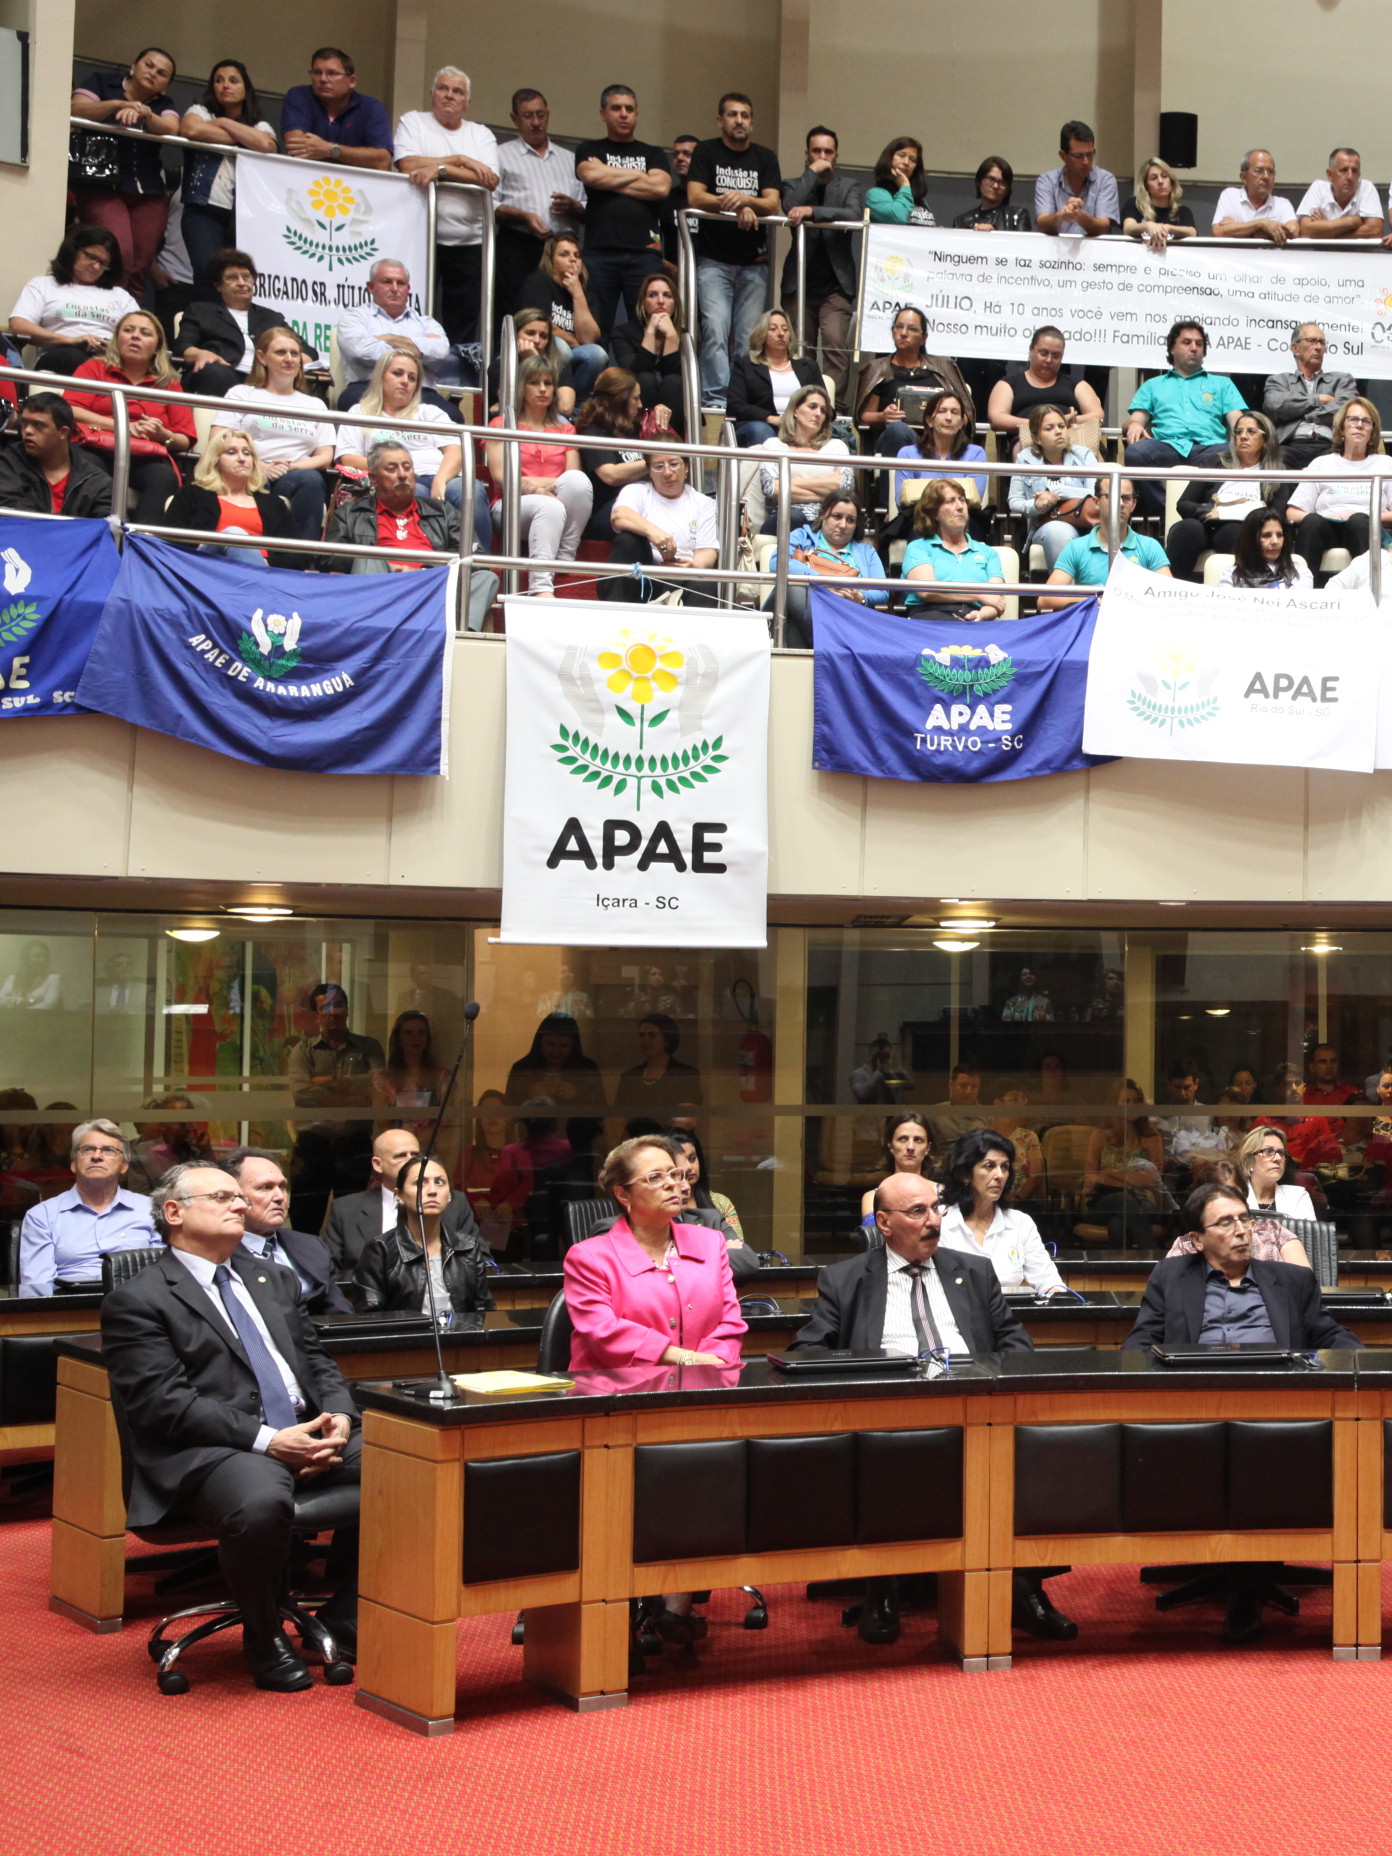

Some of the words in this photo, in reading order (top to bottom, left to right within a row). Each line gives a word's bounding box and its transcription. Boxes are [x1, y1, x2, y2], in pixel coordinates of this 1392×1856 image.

[927, 270, 973, 283] palavra
[977, 272, 993, 284] de
[997, 272, 1053, 289] incentivo,
[1057, 278, 1077, 288] um
[1081, 280, 1113, 292] gesto
[1117, 280, 1133, 291] de
[1227, 288, 1254, 299] uma
[1259, 289, 1300, 303] atitude
[1304, 292, 1319, 304] de
[995, 256, 1008, 266] se
[1015, 256, 1032, 268] faz
[1039, 259, 1085, 272] sozinho:
[1092, 262, 1137, 275] sempre
[1234, 273, 1262, 284] olhar
[1270, 274, 1286, 285] de
[1293, 275, 1330, 289] apoio,
[1337, 278, 1365, 288] uma
[311, 280, 332, 307] SR.
[926, 289, 977, 314] JÚLIO,
[984, 300, 1002, 314] Há
[1010, 303, 1025, 315] 10
[1031, 306, 1064, 318] anos
[1070, 306, 1103, 320] você
[1109, 311, 1138, 322] vem
[1145, 312, 1168, 323] nos
[926, 319, 969, 335] Nosso
[974, 323, 1018, 338] muito
[1112, 330, 1168, 347] Família
[1216, 335, 1252, 350] APAE
[1342, 340, 1364, 356] Sul
[1143, 586, 1199, 600] Amigo
[1285, 598, 1341, 611] Ascari
[188, 633, 227, 668] APAE
[228, 661, 250, 682] DE
[253, 671, 355, 698] ARARANGUÁ
[1, 694, 41, 709] SUL
[52, 690, 76, 703] SC
[1243, 671, 1340, 703] APAE
[925, 704, 1013, 731] APAE
[1250, 703, 1266, 713] Rio
[1288, 705, 1304, 715] Sul
[1315, 707, 1331, 716] SC
[914, 733, 981, 752] TURVO
[1001, 734, 1024, 751] SC
[546, 817, 728, 874] APAE
[596, 893, 638, 911] Içara
[655, 895, 680, 911] SC
